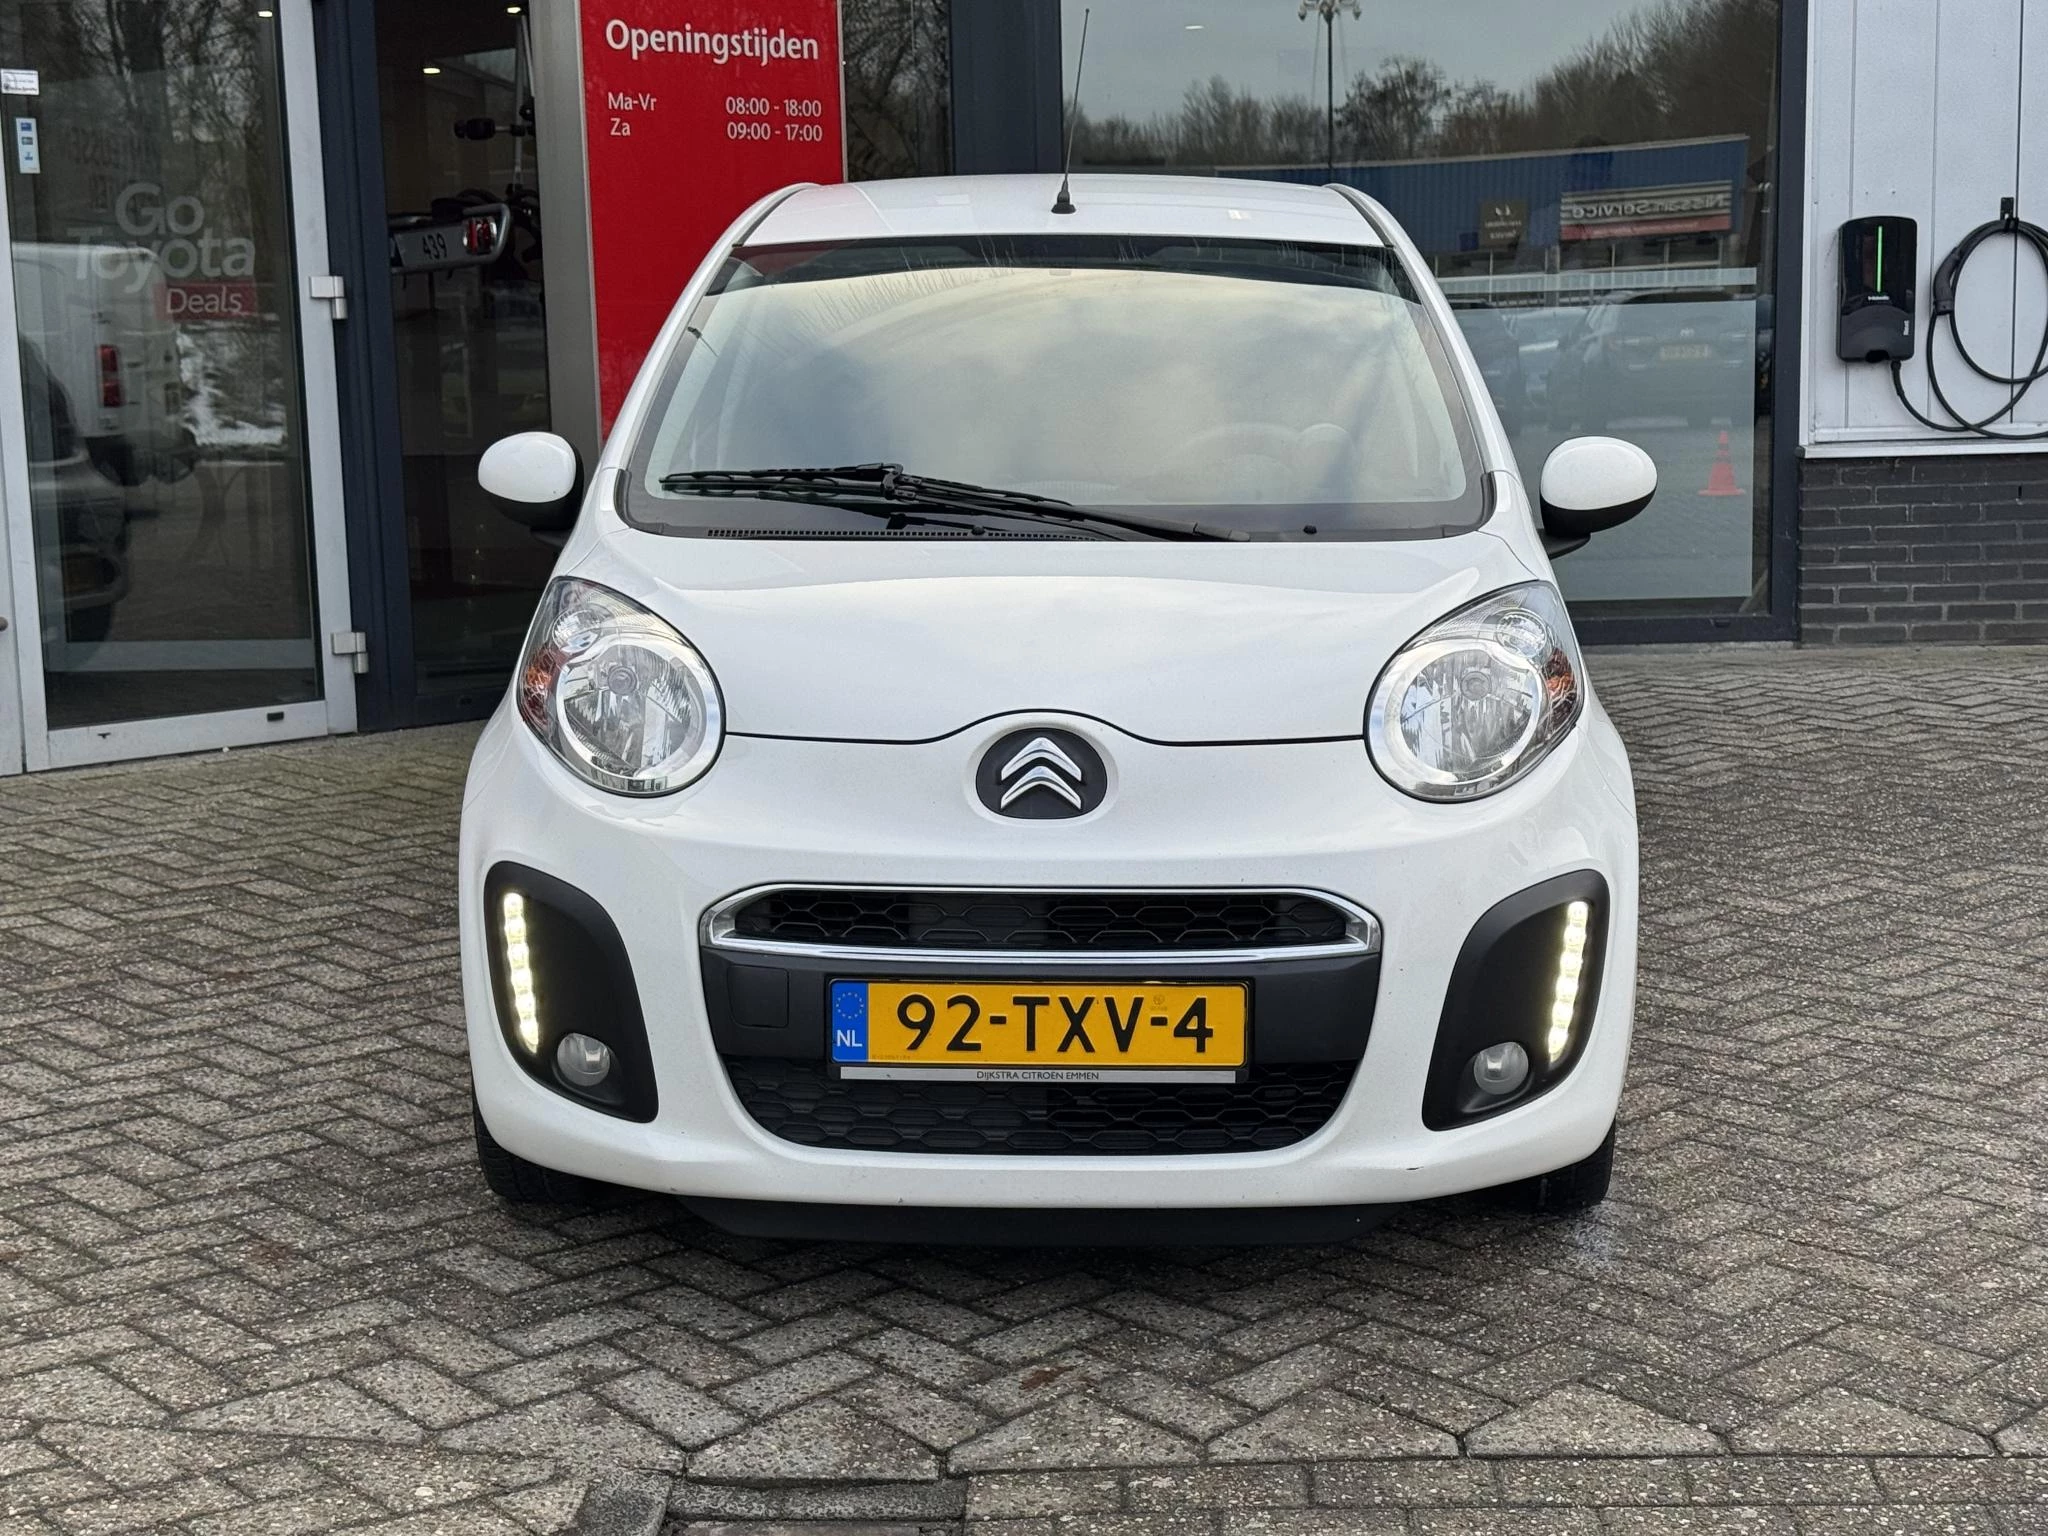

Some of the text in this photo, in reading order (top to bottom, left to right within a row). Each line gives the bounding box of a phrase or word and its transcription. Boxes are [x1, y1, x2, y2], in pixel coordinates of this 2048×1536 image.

[605, 19, 819, 67] Openingstijden
[608, 92, 657, 111] Ma-Vr
[726, 97, 769, 115] 08:00
[784, 99, 822, 117] 18:00
[610, 118, 631, 136] Za
[727, 122, 771, 140] 09:00
[785, 124, 823, 141] 17:00
[115, 182, 205, 236] Go
[421, 232, 448, 259] 439
[67, 227, 256, 293] Toyota
[166, 286, 243, 313] Deals
[897, 993, 1214, 1053] 92-TXV-4
[836, 1029, 863, 1048] NL
[1065, 1071, 1100, 1080] EMMEN
